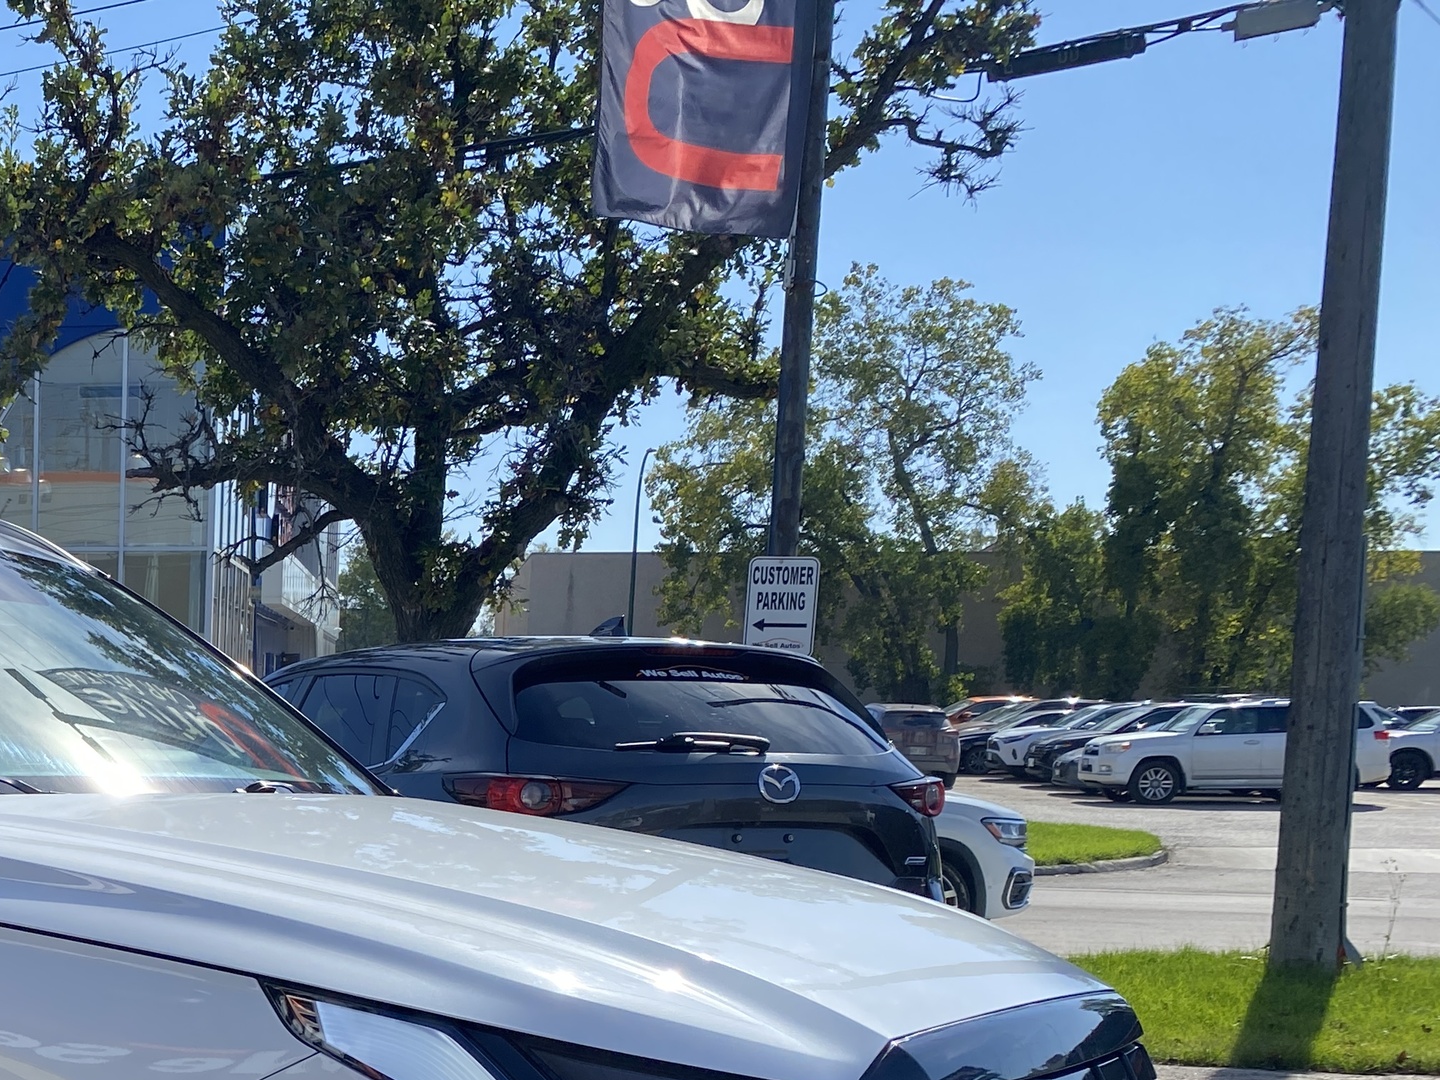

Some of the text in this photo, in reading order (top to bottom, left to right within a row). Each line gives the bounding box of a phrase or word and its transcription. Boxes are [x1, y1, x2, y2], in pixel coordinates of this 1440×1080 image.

[752, 566, 814, 585] CUSTOMER
[756, 592, 806, 611] PARKING
[640, 669, 744, 680] We Sell Autos
